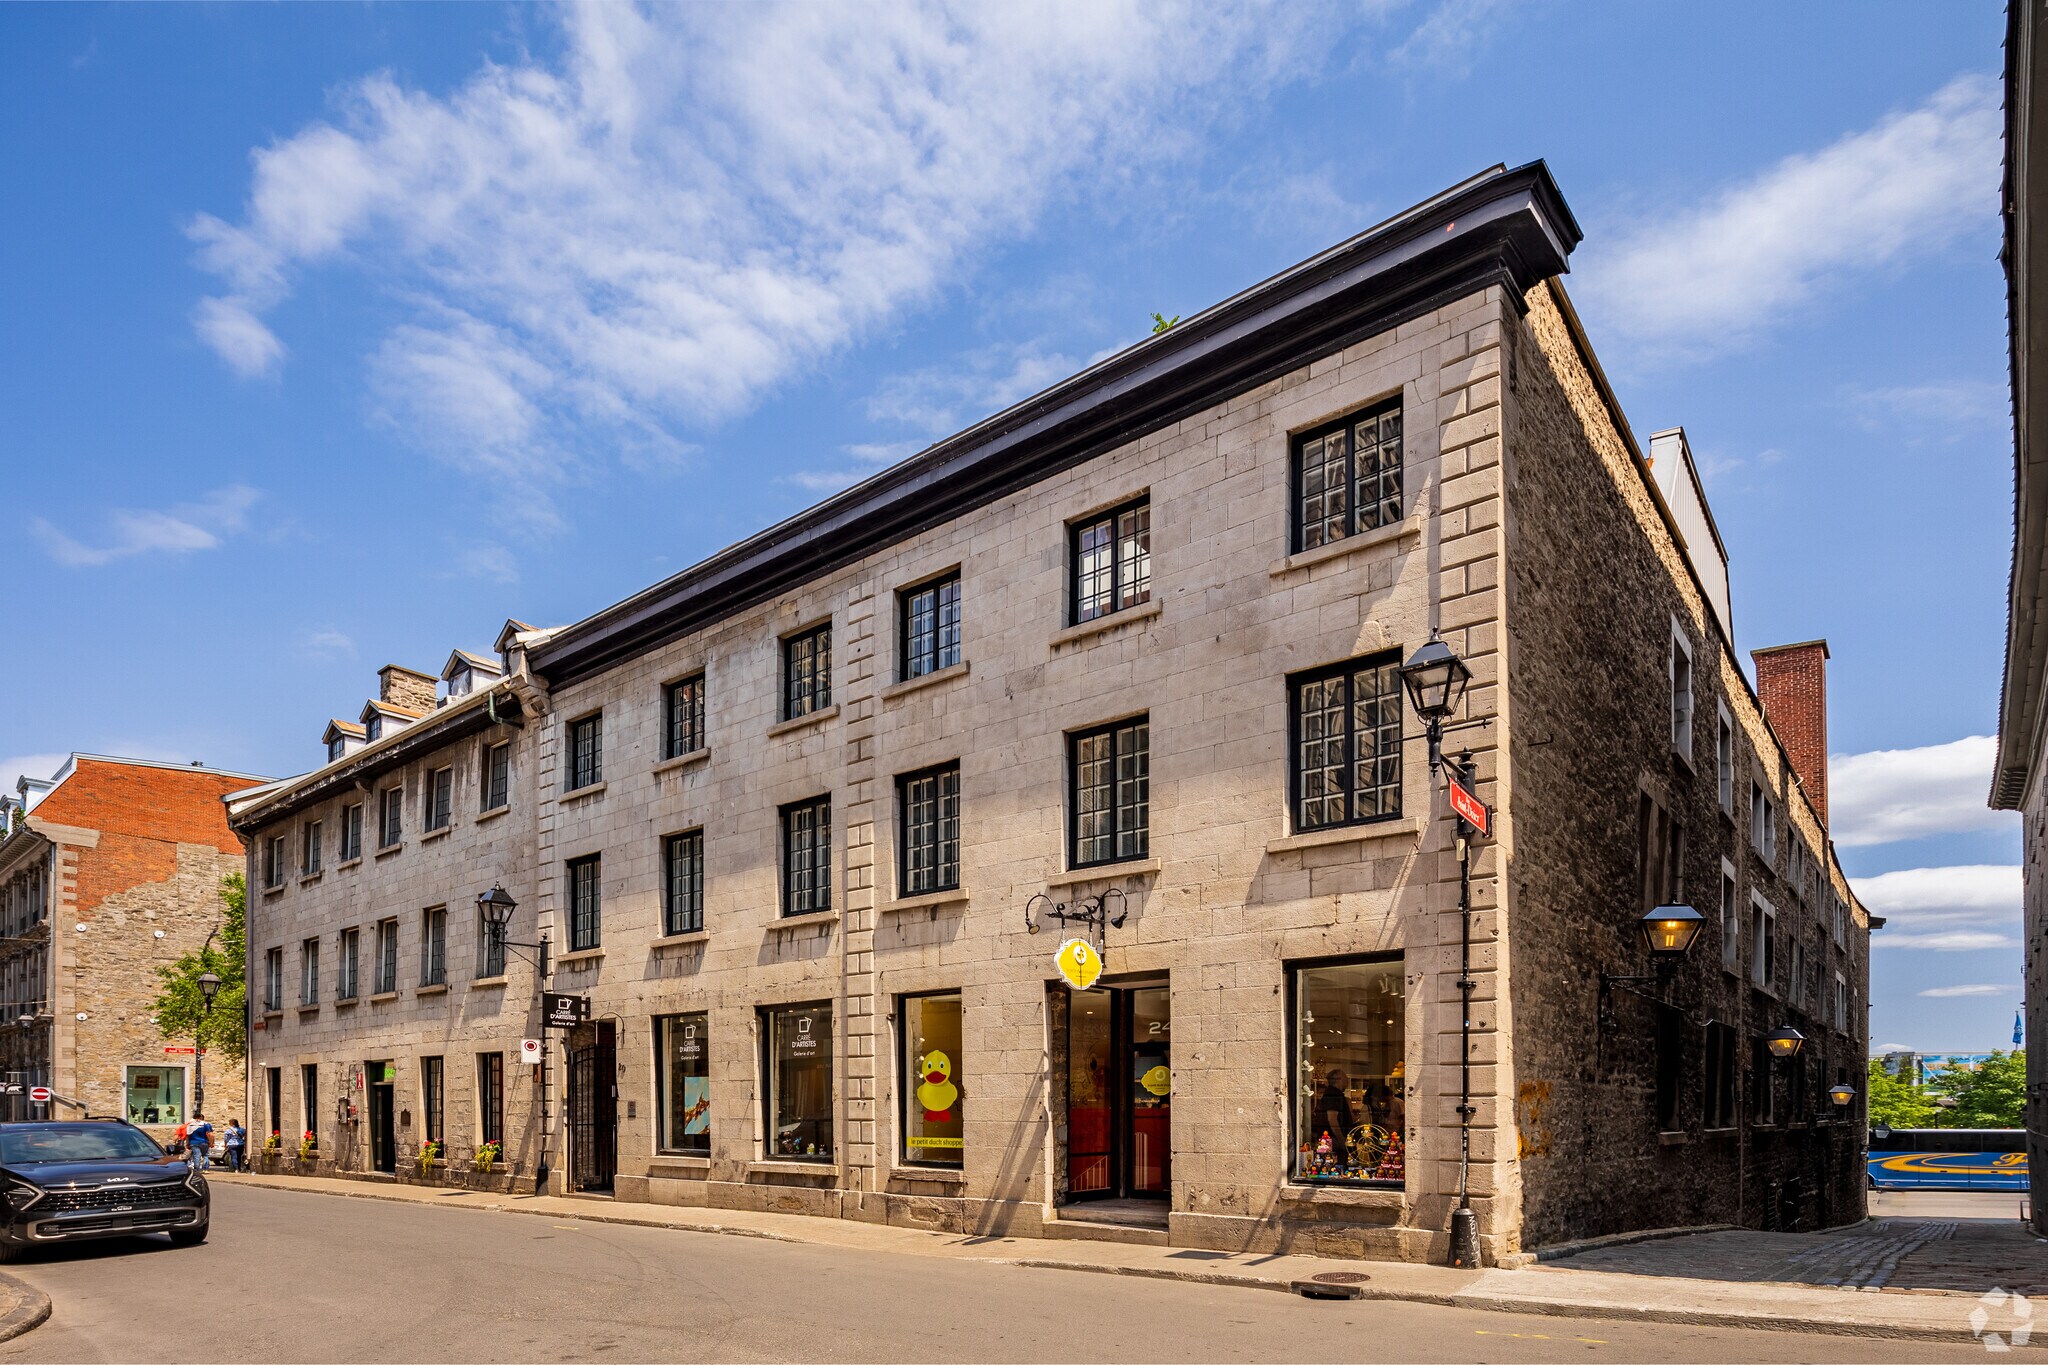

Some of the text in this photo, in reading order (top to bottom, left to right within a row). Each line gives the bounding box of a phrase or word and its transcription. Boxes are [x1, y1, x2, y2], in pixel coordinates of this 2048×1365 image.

[791, 1039, 817, 1048] D'ARTISTES
[679, 1045, 701, 1053] D'ARTISTES
[916, 1138, 929, 1146] petit
